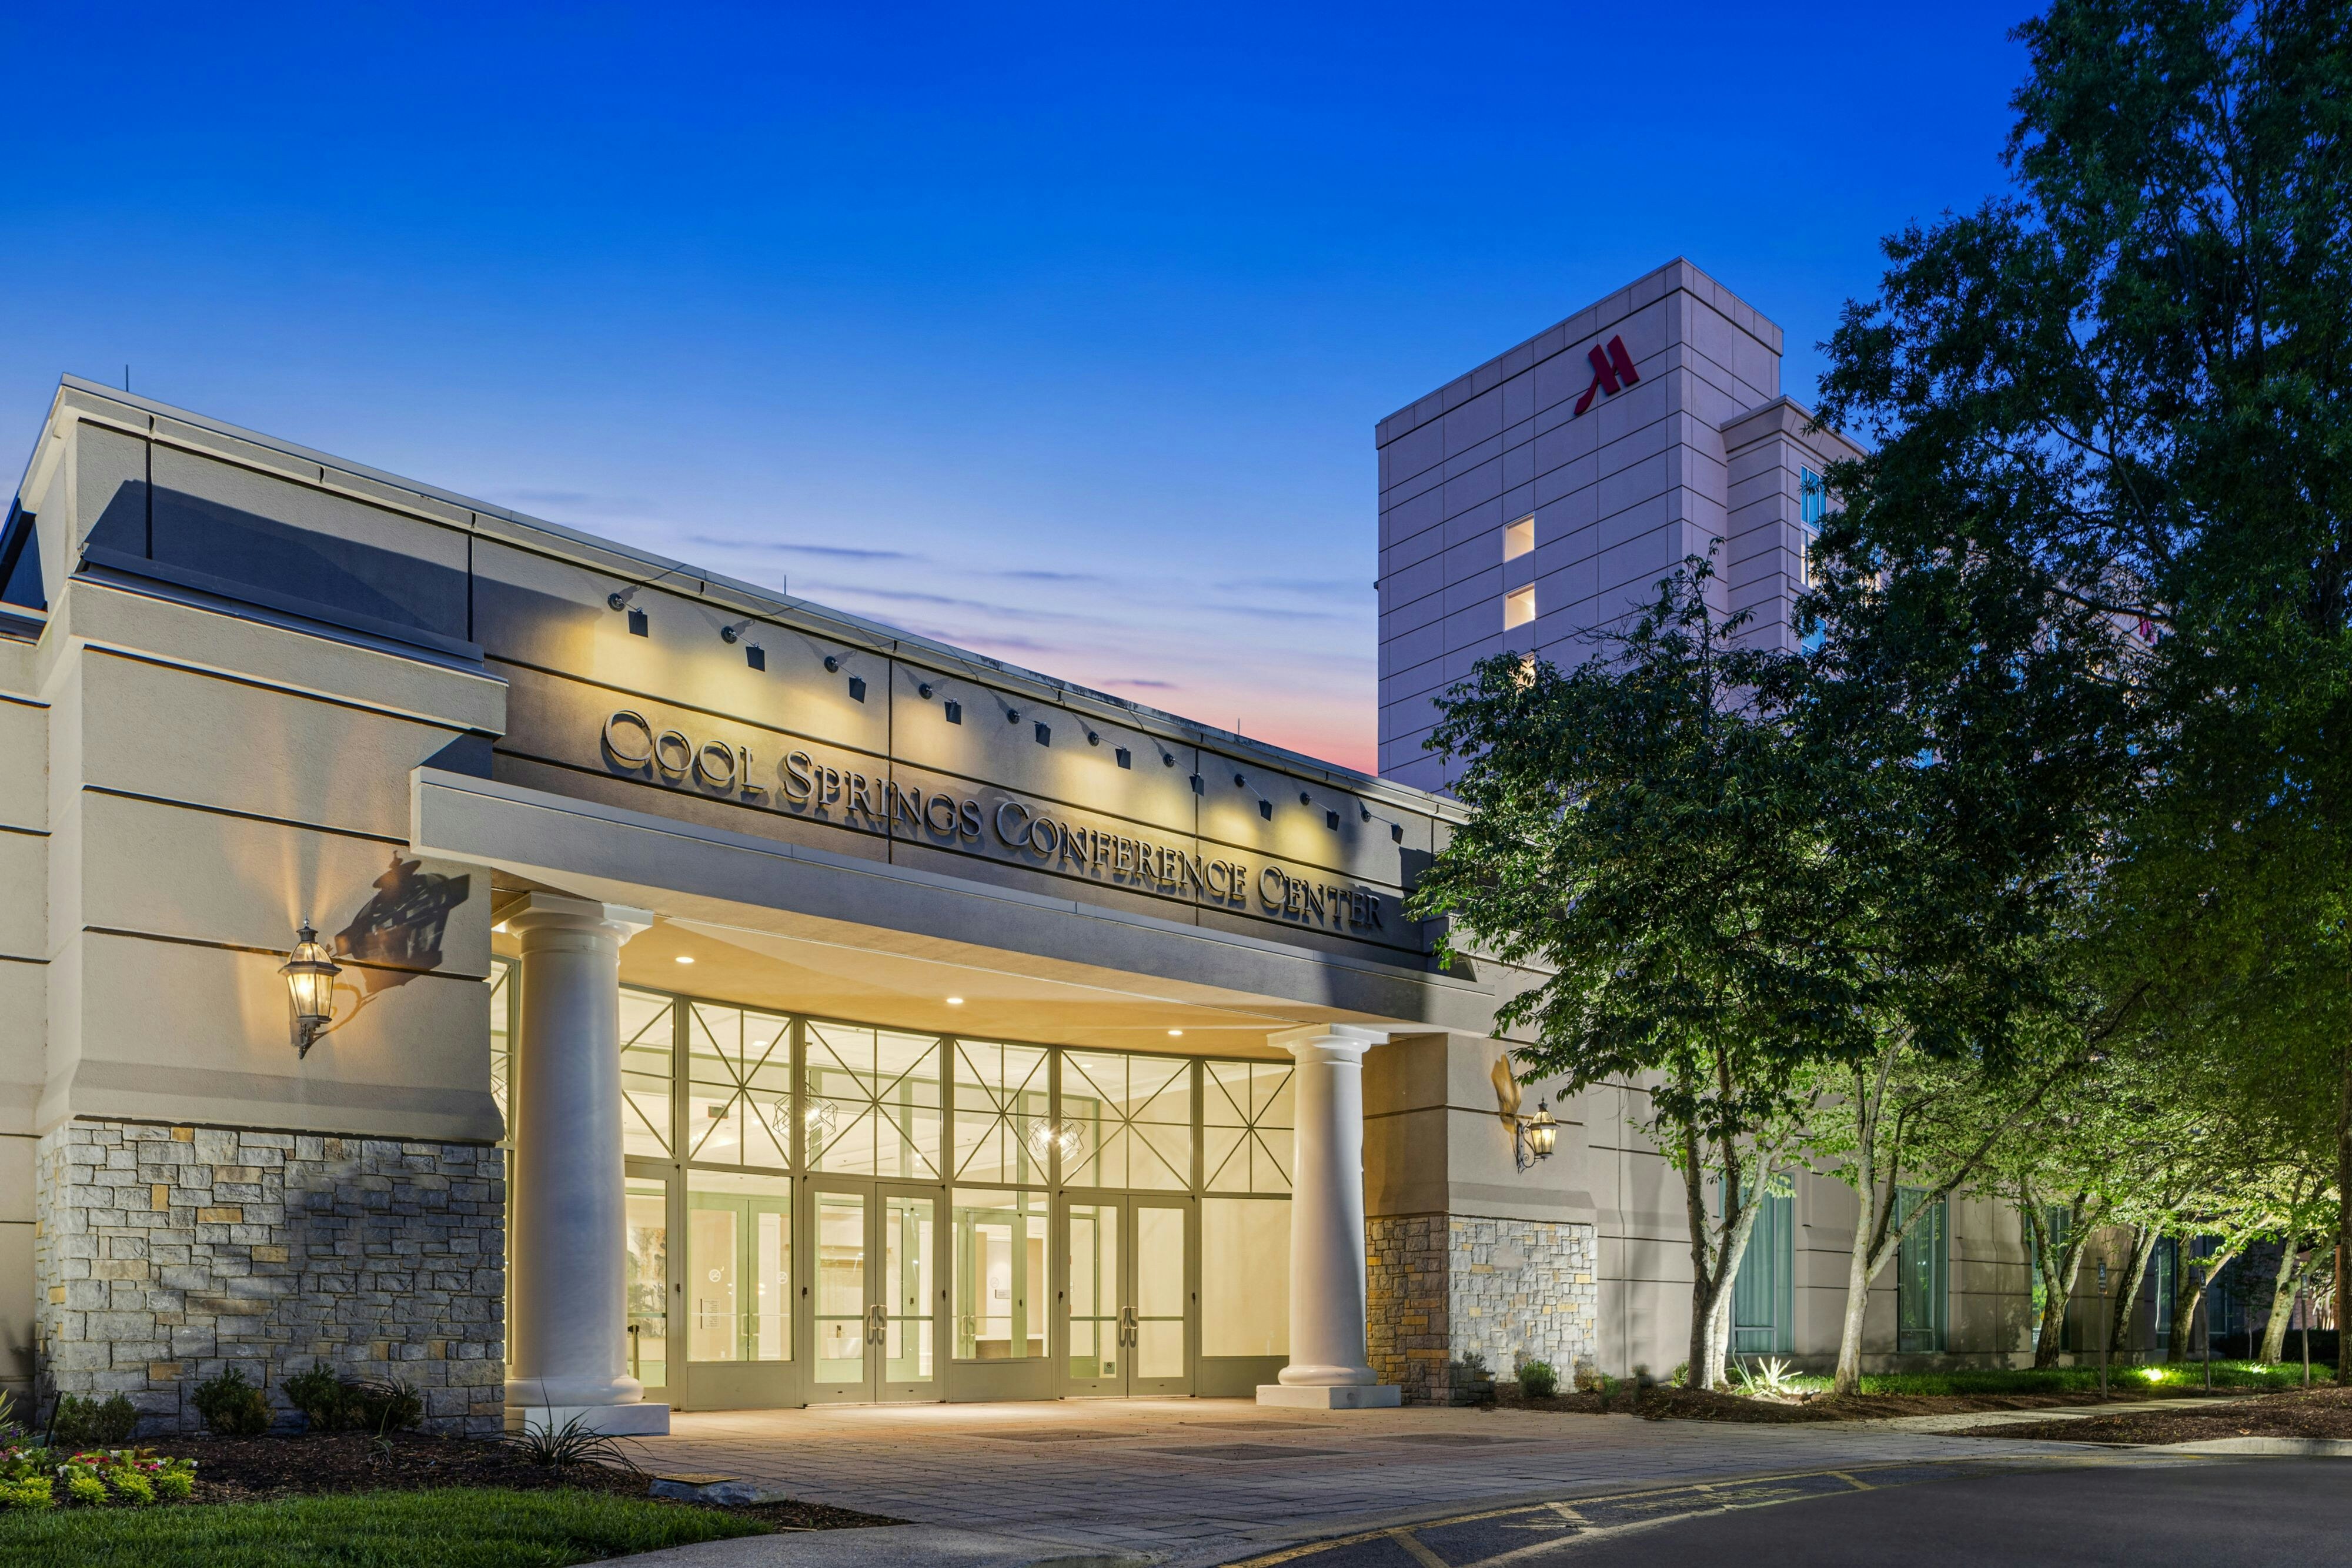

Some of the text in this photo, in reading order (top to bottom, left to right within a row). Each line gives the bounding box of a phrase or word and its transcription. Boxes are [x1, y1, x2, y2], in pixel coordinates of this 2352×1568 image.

[605, 710, 1384, 928] COOL SPRINGS CONFERENCE CENTER
